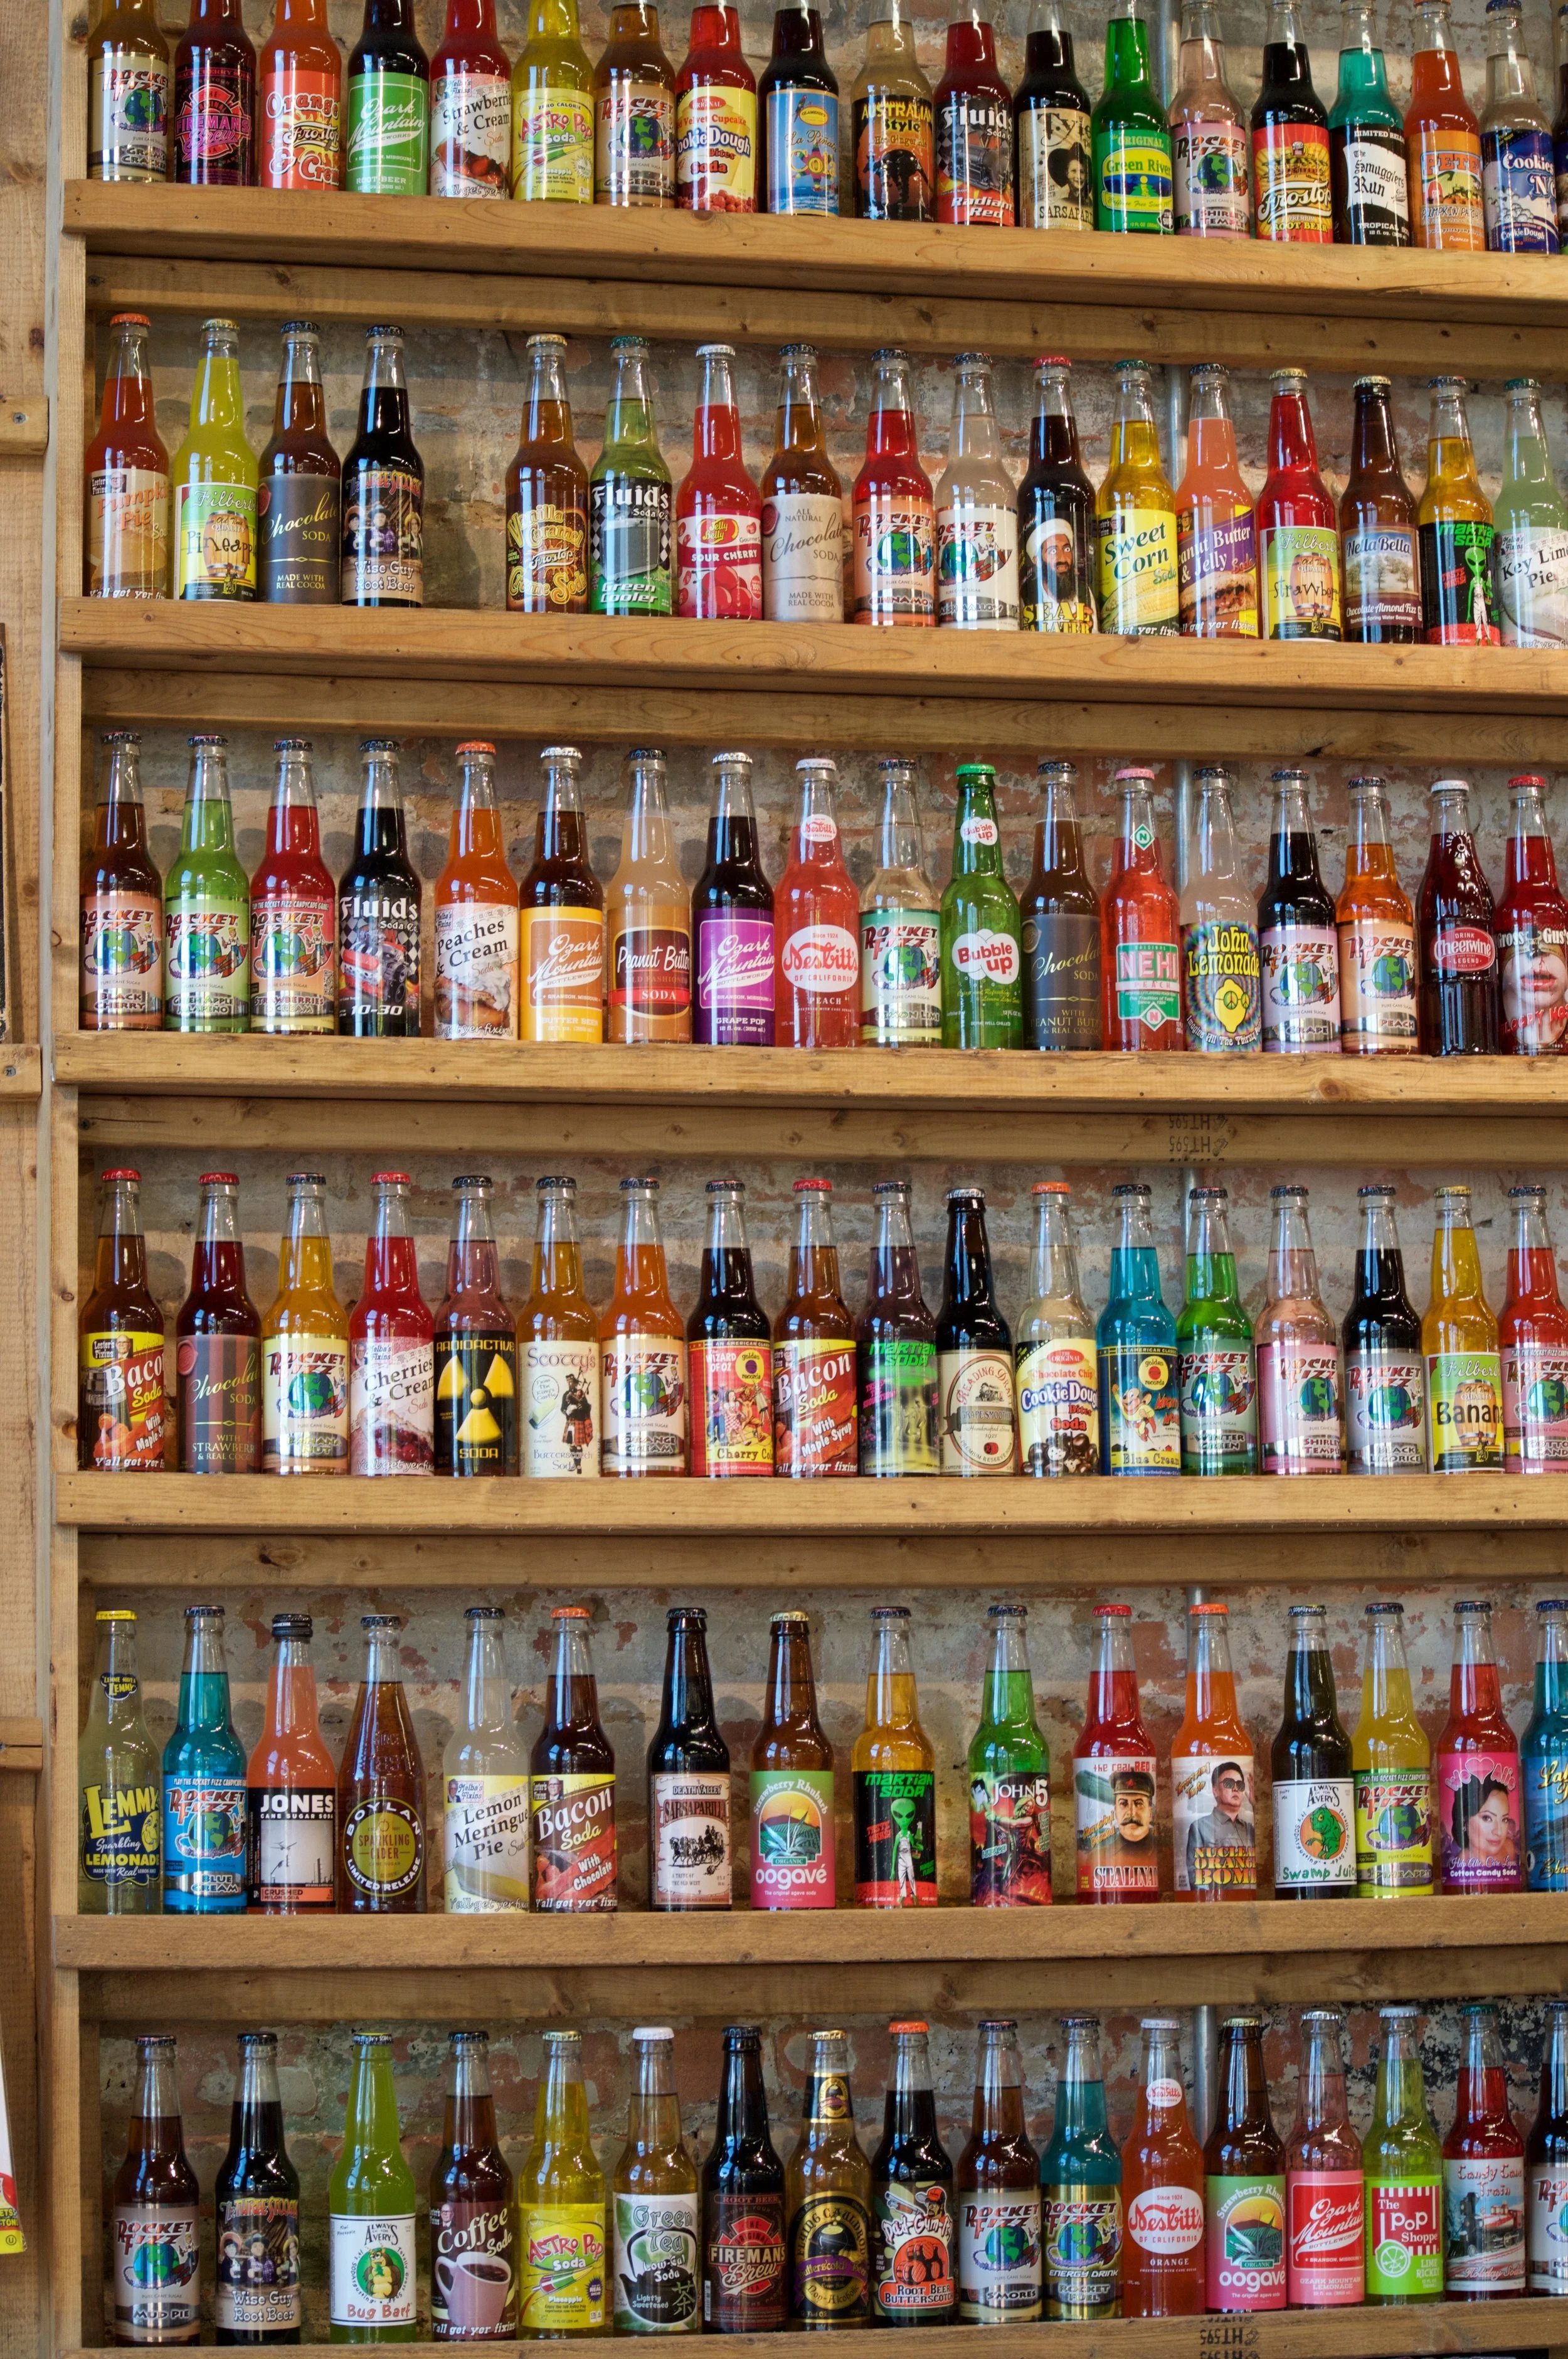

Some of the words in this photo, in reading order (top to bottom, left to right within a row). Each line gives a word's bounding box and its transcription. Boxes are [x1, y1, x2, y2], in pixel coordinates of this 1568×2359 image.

[265, 89, 340, 119] Orange
[361, 99, 416, 123] Ozark
[177, 114, 250, 133] FIREMANS
[712, 114, 746, 125] Cupcake
[941, 105, 1012, 128] Fluids
[348, 115, 424, 147] Mountain
[457, 122, 469, 136] &
[474, 113, 509, 130] Cream
[883, 118, 920, 133] Style
[545, 131, 577, 146] Soda
[987, 129, 1003, 137] Soda
[1354, 130, 1387, 138] LIMITED
[707, 126, 751, 157] Dough
[1118, 136, 1163, 148] ORIGINAL
[709, 148, 735, 159] Bites
[690, 161, 728, 174] Soda
[1106, 158, 1143, 173] Green
[1148, 158, 1170, 175] River
[1502, 152, 1554, 172] Cookies
[1354, 176, 1385, 196] Run
[970, 207, 1003, 218] Red
[1358, 222, 1399, 231] TROPICAL
[633, 508, 656, 518] Soda
[708, 519, 728, 531] Jelly
[302, 530, 331, 542] SODA
[702, 531, 724, 543] Belly
[1212, 526, 1251, 547] Butter
[1104, 522, 1166, 565] Sweet
[691, 553, 719, 563] SOUR
[723, 549, 757, 561] CHERRY
[354, 561, 387, 577] Wise
[389, 562, 413, 578] Guy
[1114, 547, 1169, 580] Corn
[1503, 556, 1533, 581] Key
[277, 574, 301, 582] MADE
[302, 574, 324, 583] WITH
[356, 577, 384, 591] Root
[387, 577, 415, 593] Beer
[1528, 572, 1554, 589] Pie
[277, 582, 298, 590] REAL
[300, 582, 325, 590] COCOA
[602, 582, 656, 593] Green
[339, 897, 418, 920] Fluids
[379, 920, 404, 930] Soda
[437, 919, 505, 957] Peaches
[1207, 925, 1249, 953] John
[449, 939, 509, 967] Cream
[718, 934, 770, 964] Ozark
[958, 942, 1012, 964] Bubble
[1434, 939, 1491, 960] Cheerwine
[617, 946, 660, 974] Peanut
[697, 949, 775, 984] Mountain
[986, 957, 1013, 976] up
[1120, 951, 1177, 979] NEHI
[1189, 951, 1260, 977] Lemonade
[100, 992, 142, 1001] BLACK
[642, 990, 676, 1000] SODA
[810, 997, 842, 1005] PEACH
[94, 1001, 146, 1010] CHERRY
[351, 1004, 403, 1016] 10-30
[1286, 1026, 1327, 1035] GRAPE
[1380, 1020, 1414, 1028] PEACH
[1219, 1035, 1233, 1046] The
[93, 1341, 115, 1350] Lester's
[437, 1339, 514, 1352] RADIOACTIVE
[95, 1349, 114, 1358] Fixins
[884, 1355, 929, 1366] SODA
[364, 1358, 433, 1392] Cherries
[1078, 1369, 1094, 1380] Chip
[132, 1380, 162, 1408] Soda
[230, 1393, 256, 1405] SODA
[367, 1395, 383, 1407] &
[1068, 1405, 1092, 1417] Bites
[145, 1414, 161, 1431] With
[136, 1431, 157, 1452] Maple
[458, 1448, 498, 1459] SODA
[717, 1447, 758, 1461] Cherry
[1123, 1454, 1148, 1464] Blue
[1135, 1761, 1150, 1772] RED
[865, 1774, 933, 1786] MARTIAN
[672, 1786, 697, 1795] DEATH
[698, 1785, 721, 1795] VALLEY
[879, 1786, 925, 1797] SODA
[261, 1794, 334, 1813] JONES
[463, 1794, 521, 1825] Lemon
[83, 1784, 159, 1838] LEMMY
[473, 1840, 503, 1860] Pie
[577, 1854, 601, 1873] With
[116, 1866, 137, 1877] Real
[202, 1874, 232, 1883] BLUE
[573, 1861, 613, 1891] Chocolate
[1476, 1869, 1501, 1877] Candy
[191, 1883, 238, 1893] CREAM
[1378, 2198, 1399, 2210] The
[633, 2205, 693, 2229] Green
[1391, 2212, 1428, 2231] Pop
[437, 2208, 508, 2254] Coffee
[1401, 2232, 1438, 2244] Shoppe
[647, 2229, 683, 2253] Tea
[710, 2246, 786, 2264] FIREMANS
[1150, 2257, 1189, 2266] ORANGE
[1421, 2259, 1438, 2268] LIME
[654, 2270, 680, 2282] Soda
[897, 2284, 926, 2295] ROOT
[930, 2284, 950, 2294] BEER
[232, 2291, 265, 2306] Wise
[269, 2291, 294, 2306] Guy
[632, 2300, 669, 2309] Sweetened
[636, 2294, 662, 2303] Lightly
[672, 2282, 696, 2316] 茶
[133, 2309, 167, 2319] MUD
[171, 2309, 189, 2319] PIE
[233, 2306, 263, 2322] Root
[267, 2308, 294, 2321] Beer
[347, 2303, 376, 2320] Bug
[382, 2303, 411, 2318] Barf
